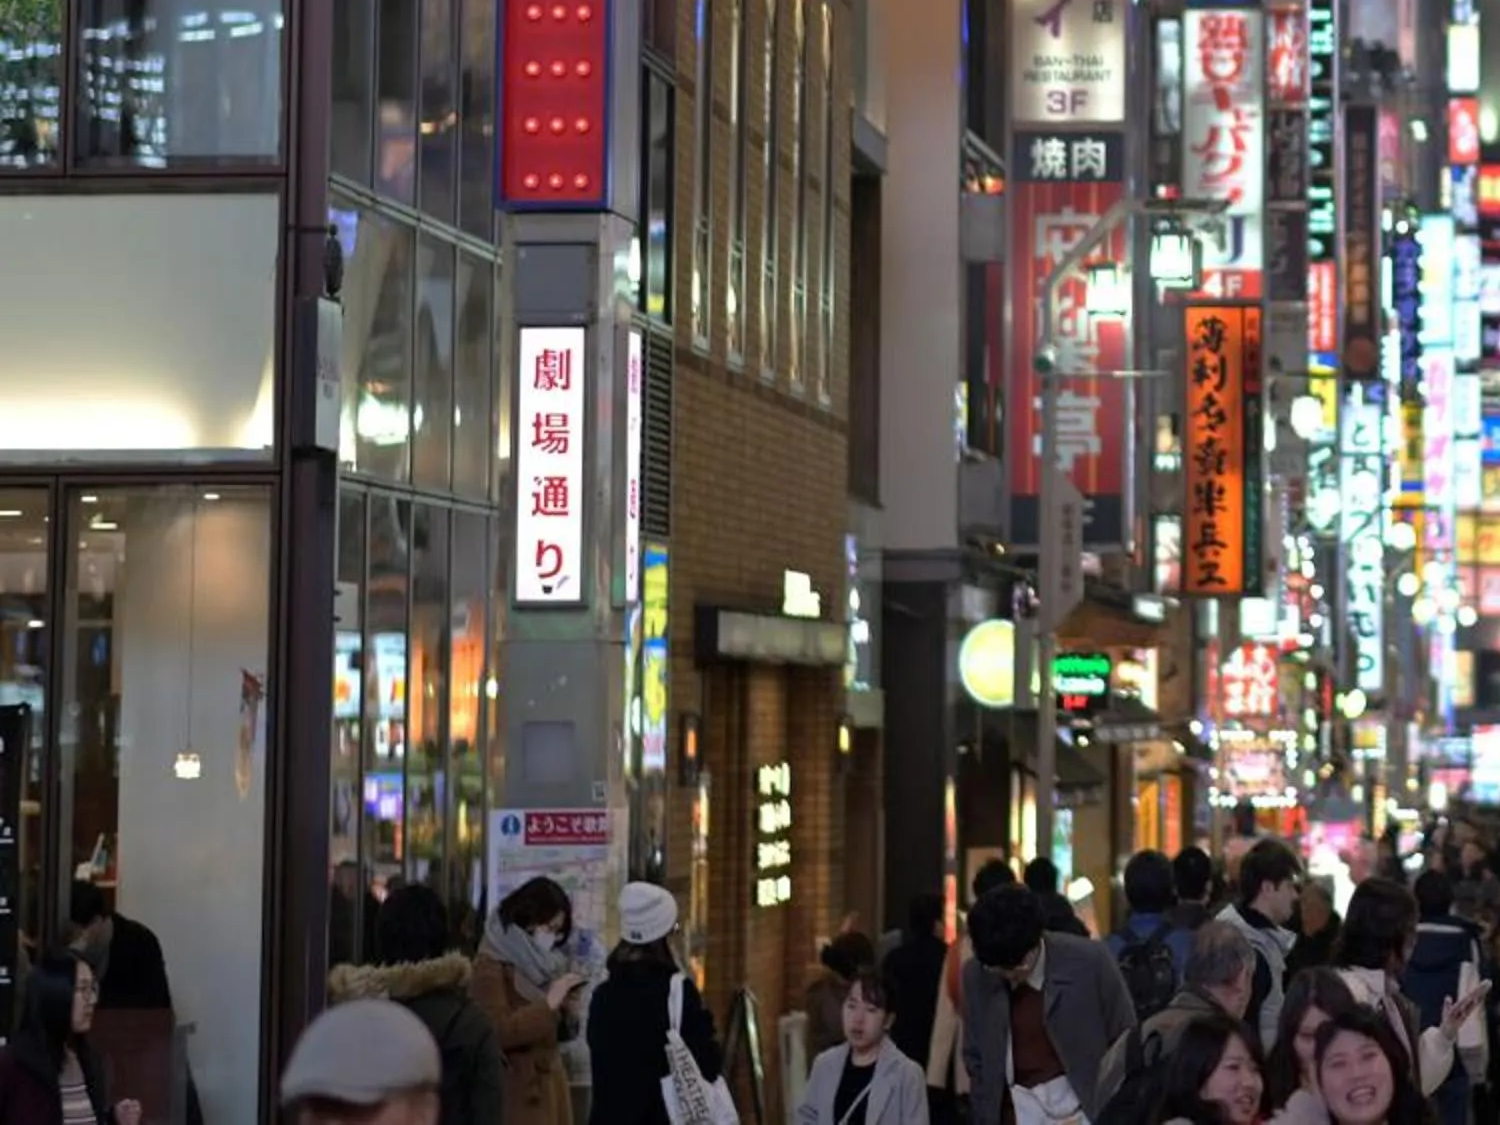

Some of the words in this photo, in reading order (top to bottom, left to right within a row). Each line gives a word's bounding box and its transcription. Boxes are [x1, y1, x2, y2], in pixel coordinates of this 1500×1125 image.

[1046, 89, 1089, 115] 3F
[1031, 137, 1107, 179] 焼肉
[532, 347, 573, 580] 劇場通り
